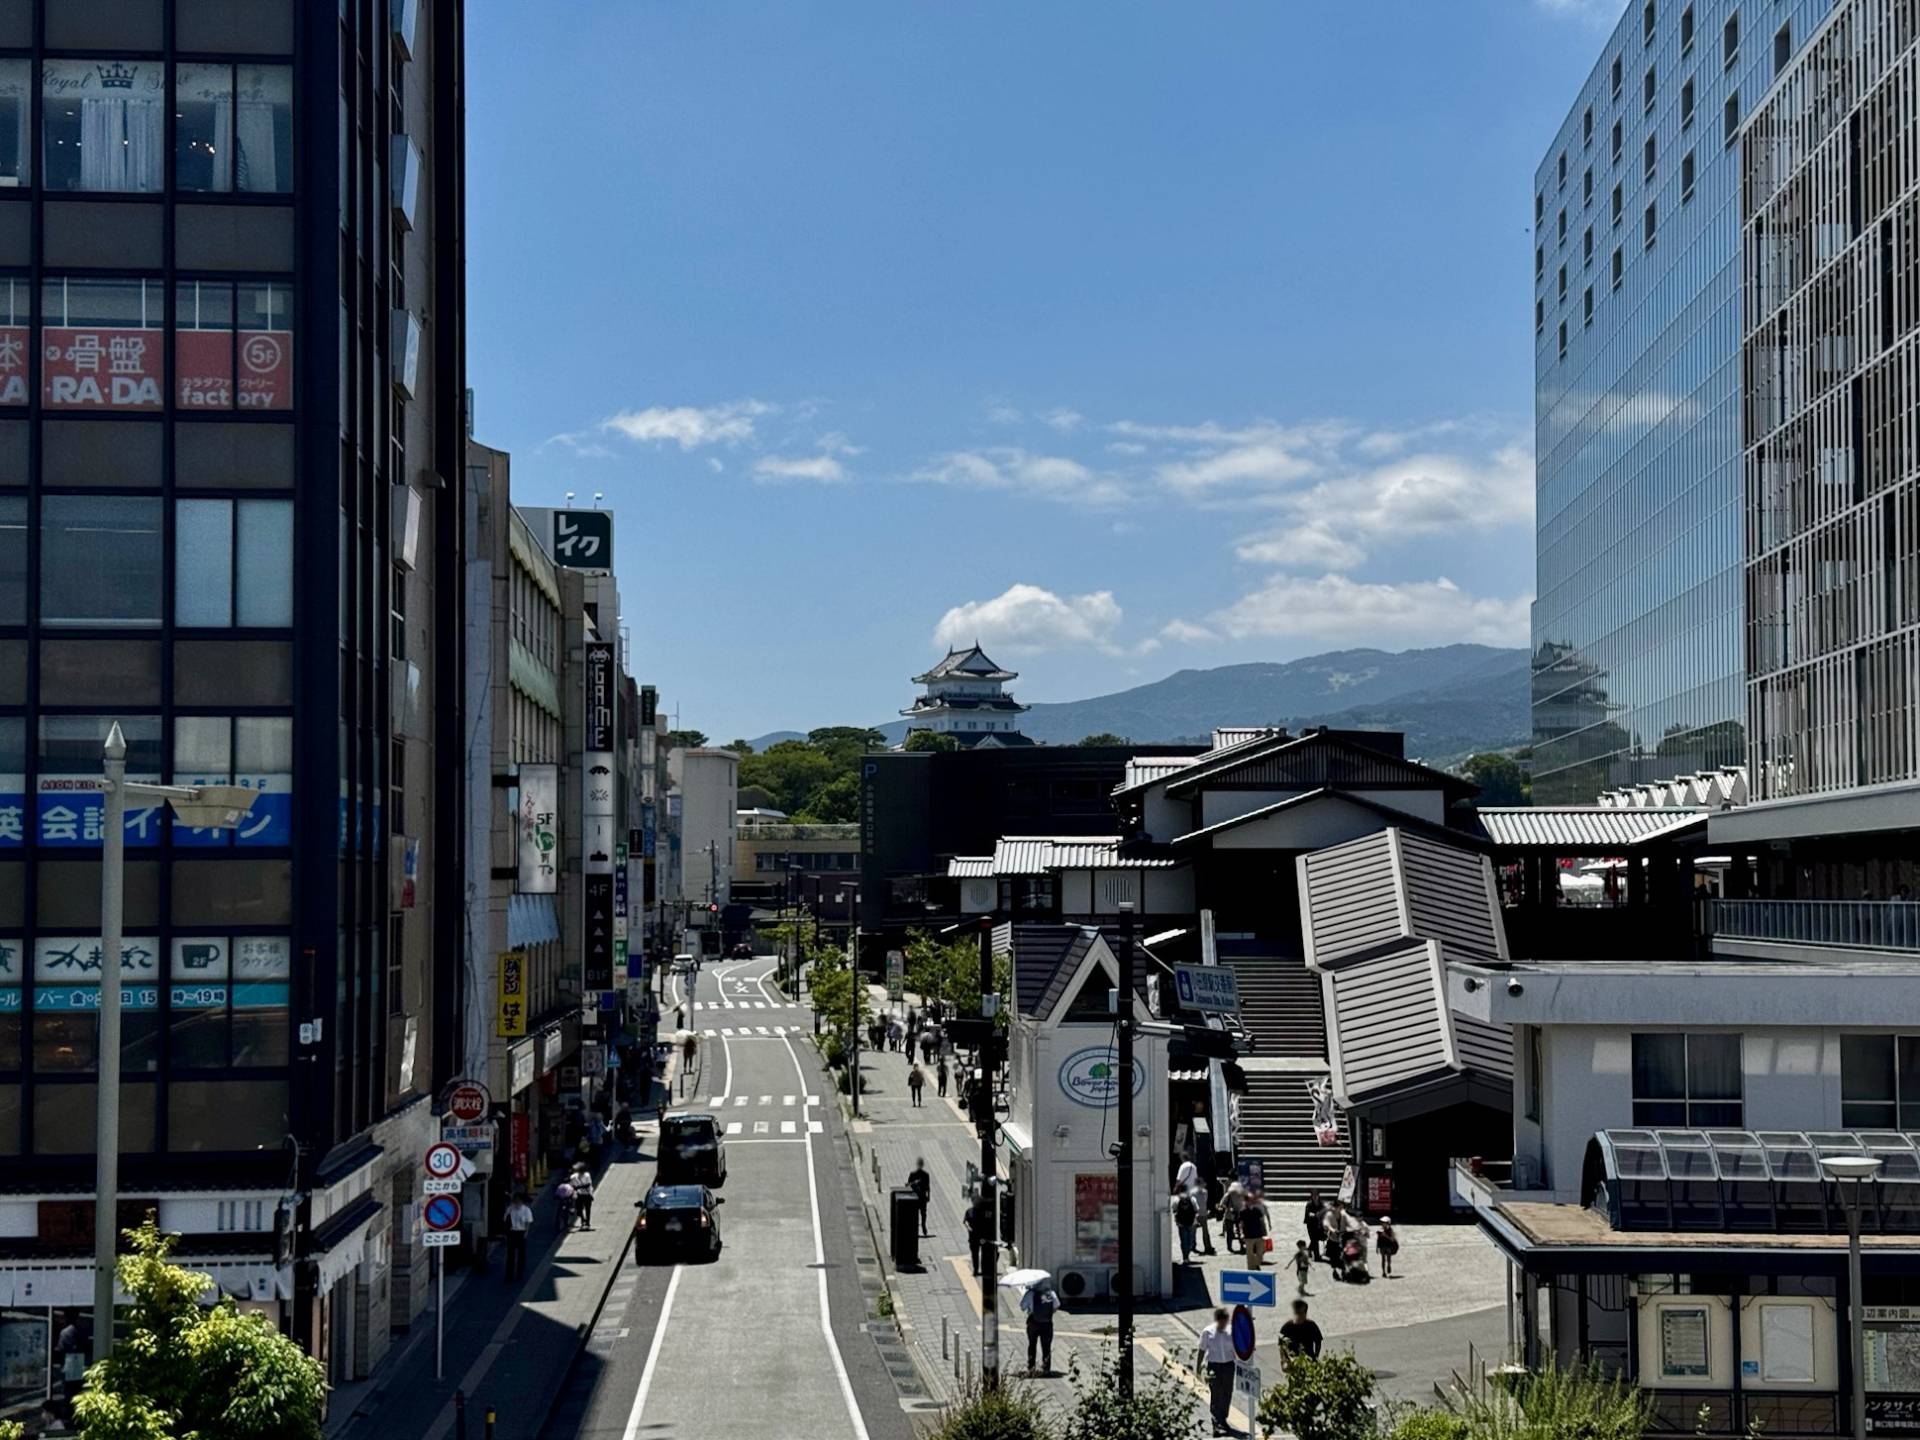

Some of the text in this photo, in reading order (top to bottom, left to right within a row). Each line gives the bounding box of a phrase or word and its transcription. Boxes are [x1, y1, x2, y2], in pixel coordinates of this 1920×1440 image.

[42, 70, 90, 94] Royal
[249, 344, 275, 364] 5F
[181, 388, 275, 408] factory
[594, 664, 611, 748] GAME
[864, 763, 878, 778] P
[537, 812, 554, 826] 5F
[433, 1153, 453, 1169] 30
[425, 1181, 459, 1191] ここから
[424, 1233, 459, 1244] ここから
[1861, 1308, 1910, 1319] 辺案内図
